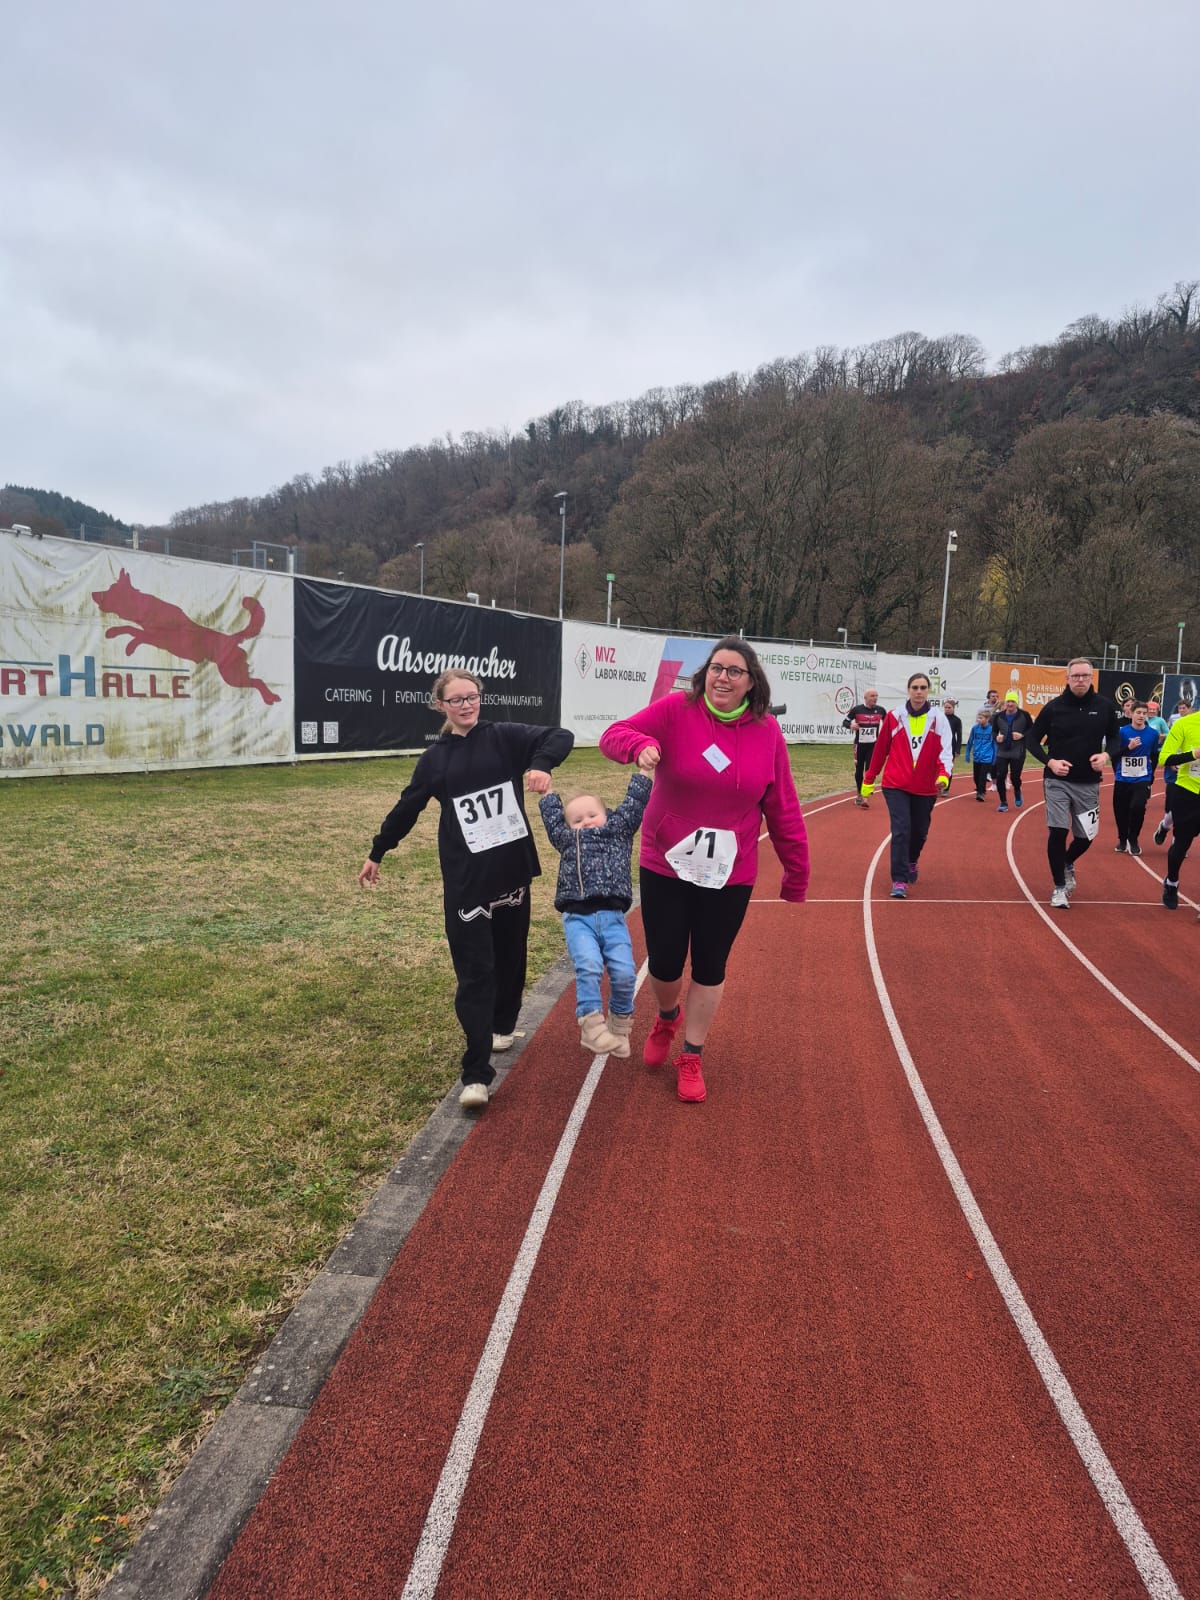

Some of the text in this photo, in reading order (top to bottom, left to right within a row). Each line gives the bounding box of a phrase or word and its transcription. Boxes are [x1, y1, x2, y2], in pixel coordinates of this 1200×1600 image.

[377, 634, 517, 680] Ahsenmacher
[595, 646, 616, 663] MVZ
[594, 668, 647, 682] LABOR KOBLENZ
[780, 671, 843, 683] WESTERWALD
[325, 688, 372, 703] CATERING
[0, 723, 105, 747] WALD
[781, 723, 815, 734] BUCHUNG
[1125, 757, 1144, 768] 580
[460, 788, 503, 824] 317
